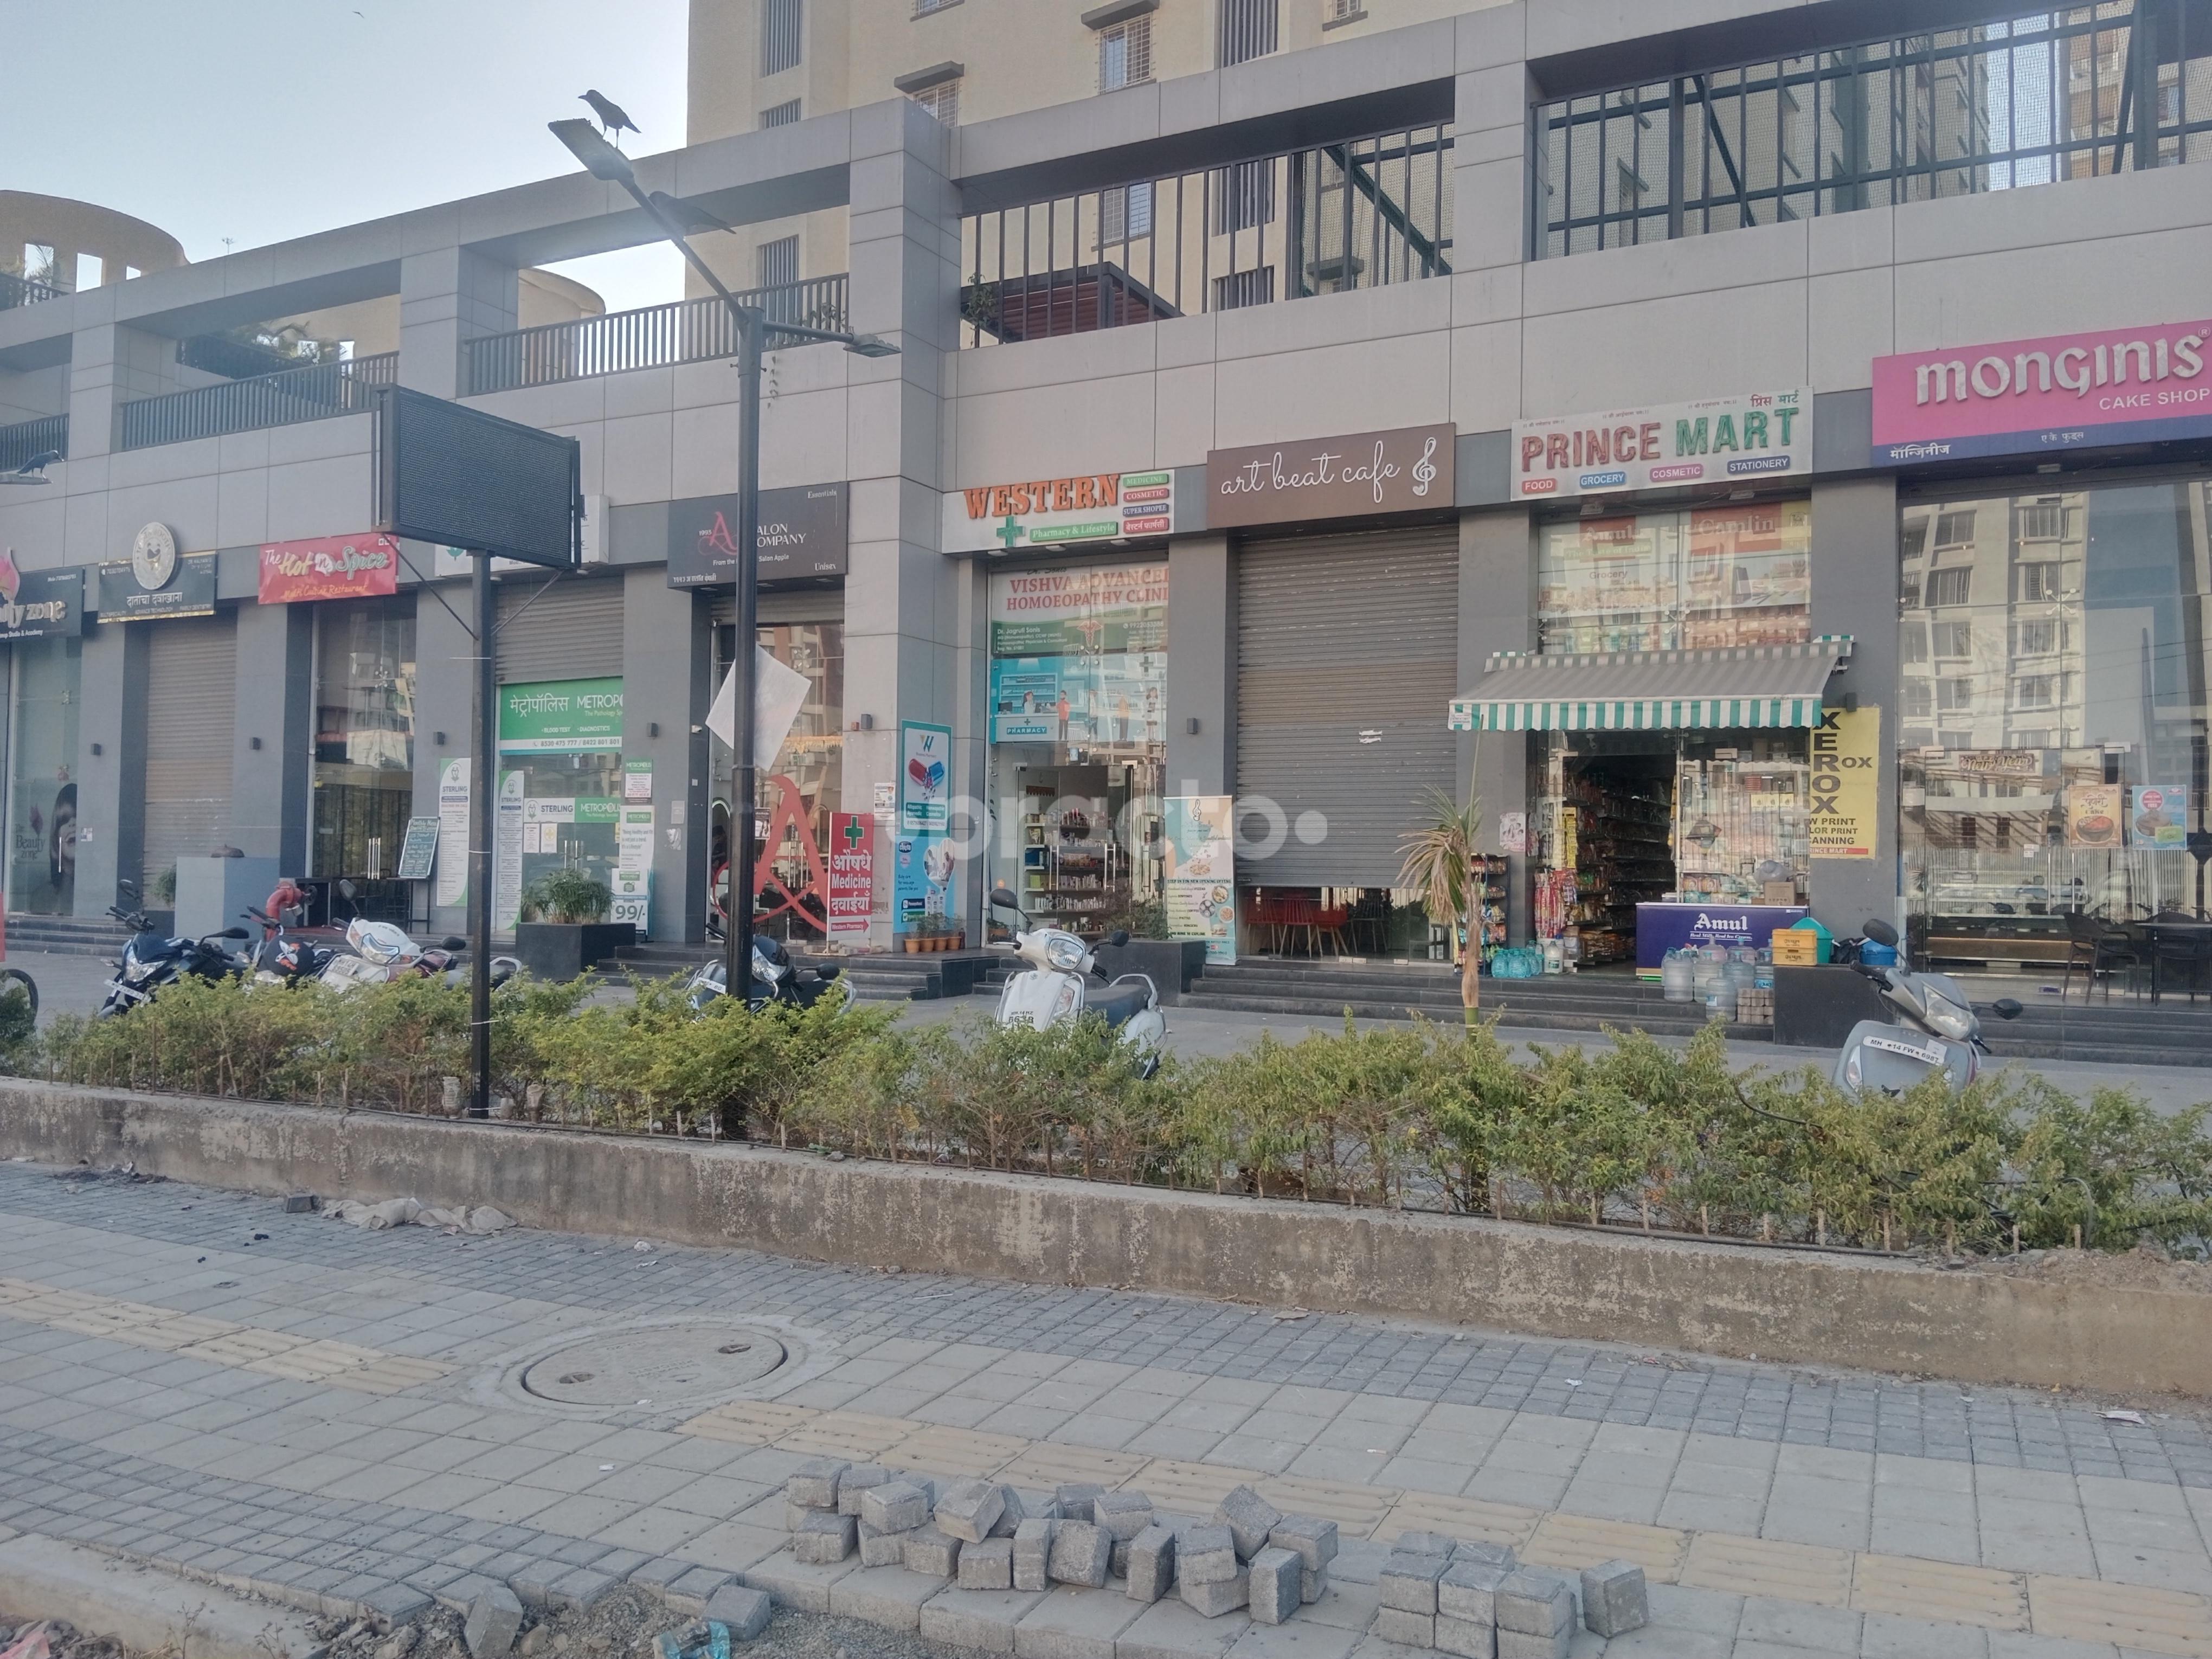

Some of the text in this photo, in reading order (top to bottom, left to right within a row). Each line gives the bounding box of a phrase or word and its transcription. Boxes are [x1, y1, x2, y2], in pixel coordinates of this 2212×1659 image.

[1778, 389, 1799, 403] मार्ट
[2099, 388, 2211, 410] CAKE SHOP
[1521, 407, 1799, 472] PRINCE MART
[1127, 475, 1164, 485] MEDICINE
[1221, 440, 1400, 503] art beat cafe
[1525, 458, 1788, 490] FOOD GROCERY COSMETIC STATIONERY
[963, 474, 1120, 519] WESTERN
[1127, 490, 1165, 500] COSMETIC
[1123, 505, 1167, 515] SUPER SHOPEE
[757, 523, 788, 536] ALON
[1033, 523, 1115, 539] Pharmacy & Lifestyle
[1583, 523, 1636, 543] Amul
[1699, 515, 1774, 537] Camlin
[757, 533, 806, 548] OMPANY
[265, 549, 281, 565] The
[279, 551, 314, 576] Hot
[336, 546, 390, 580] Spice
[774, 554, 789, 562] Apple
[1010, 568, 1168, 593] VISHVA ADVANCE
[1589, 569, 1628, 580] Grocery
[329, 584, 368, 595] Restaurant
[1006, 587, 1168, 611] HOMOEOPATHY CLINI
[510, 693, 569, 717] मेट्रोपॉलिस
[1811, 711, 1841, 814] XEROX
[16, 835, 45, 852] Beauty
[832, 873, 871, 889] Medicine
[1694, 912, 1748, 930] Amul
